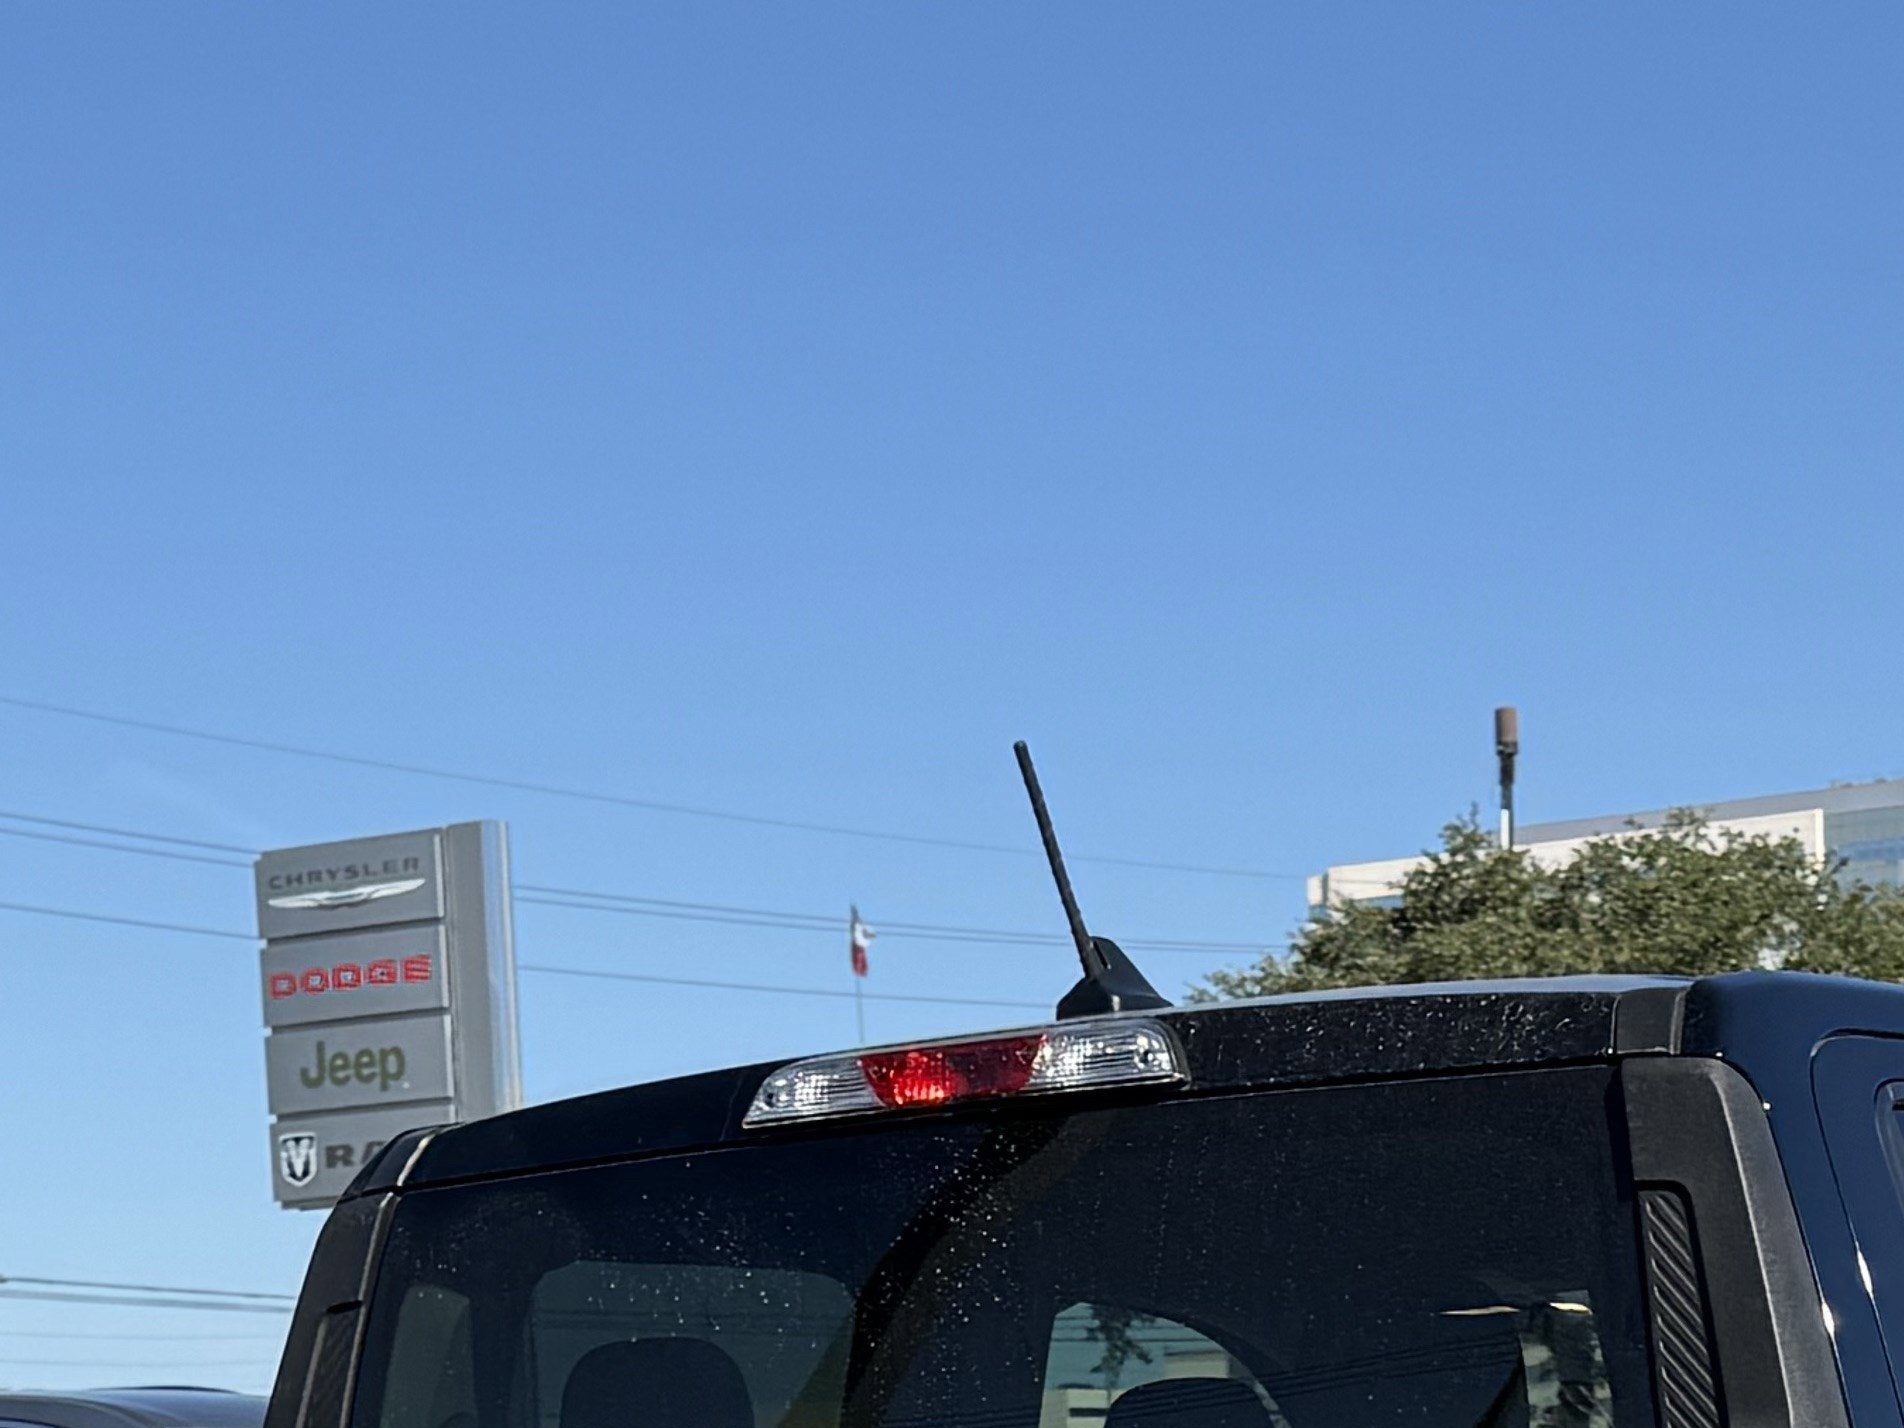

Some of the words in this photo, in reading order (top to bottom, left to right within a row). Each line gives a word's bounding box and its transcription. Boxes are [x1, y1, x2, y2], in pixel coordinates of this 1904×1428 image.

[268, 857, 419, 890] CHRYSLER
[268, 954, 432, 999] DODGE
[300, 1041, 406, 1091] Jeep
